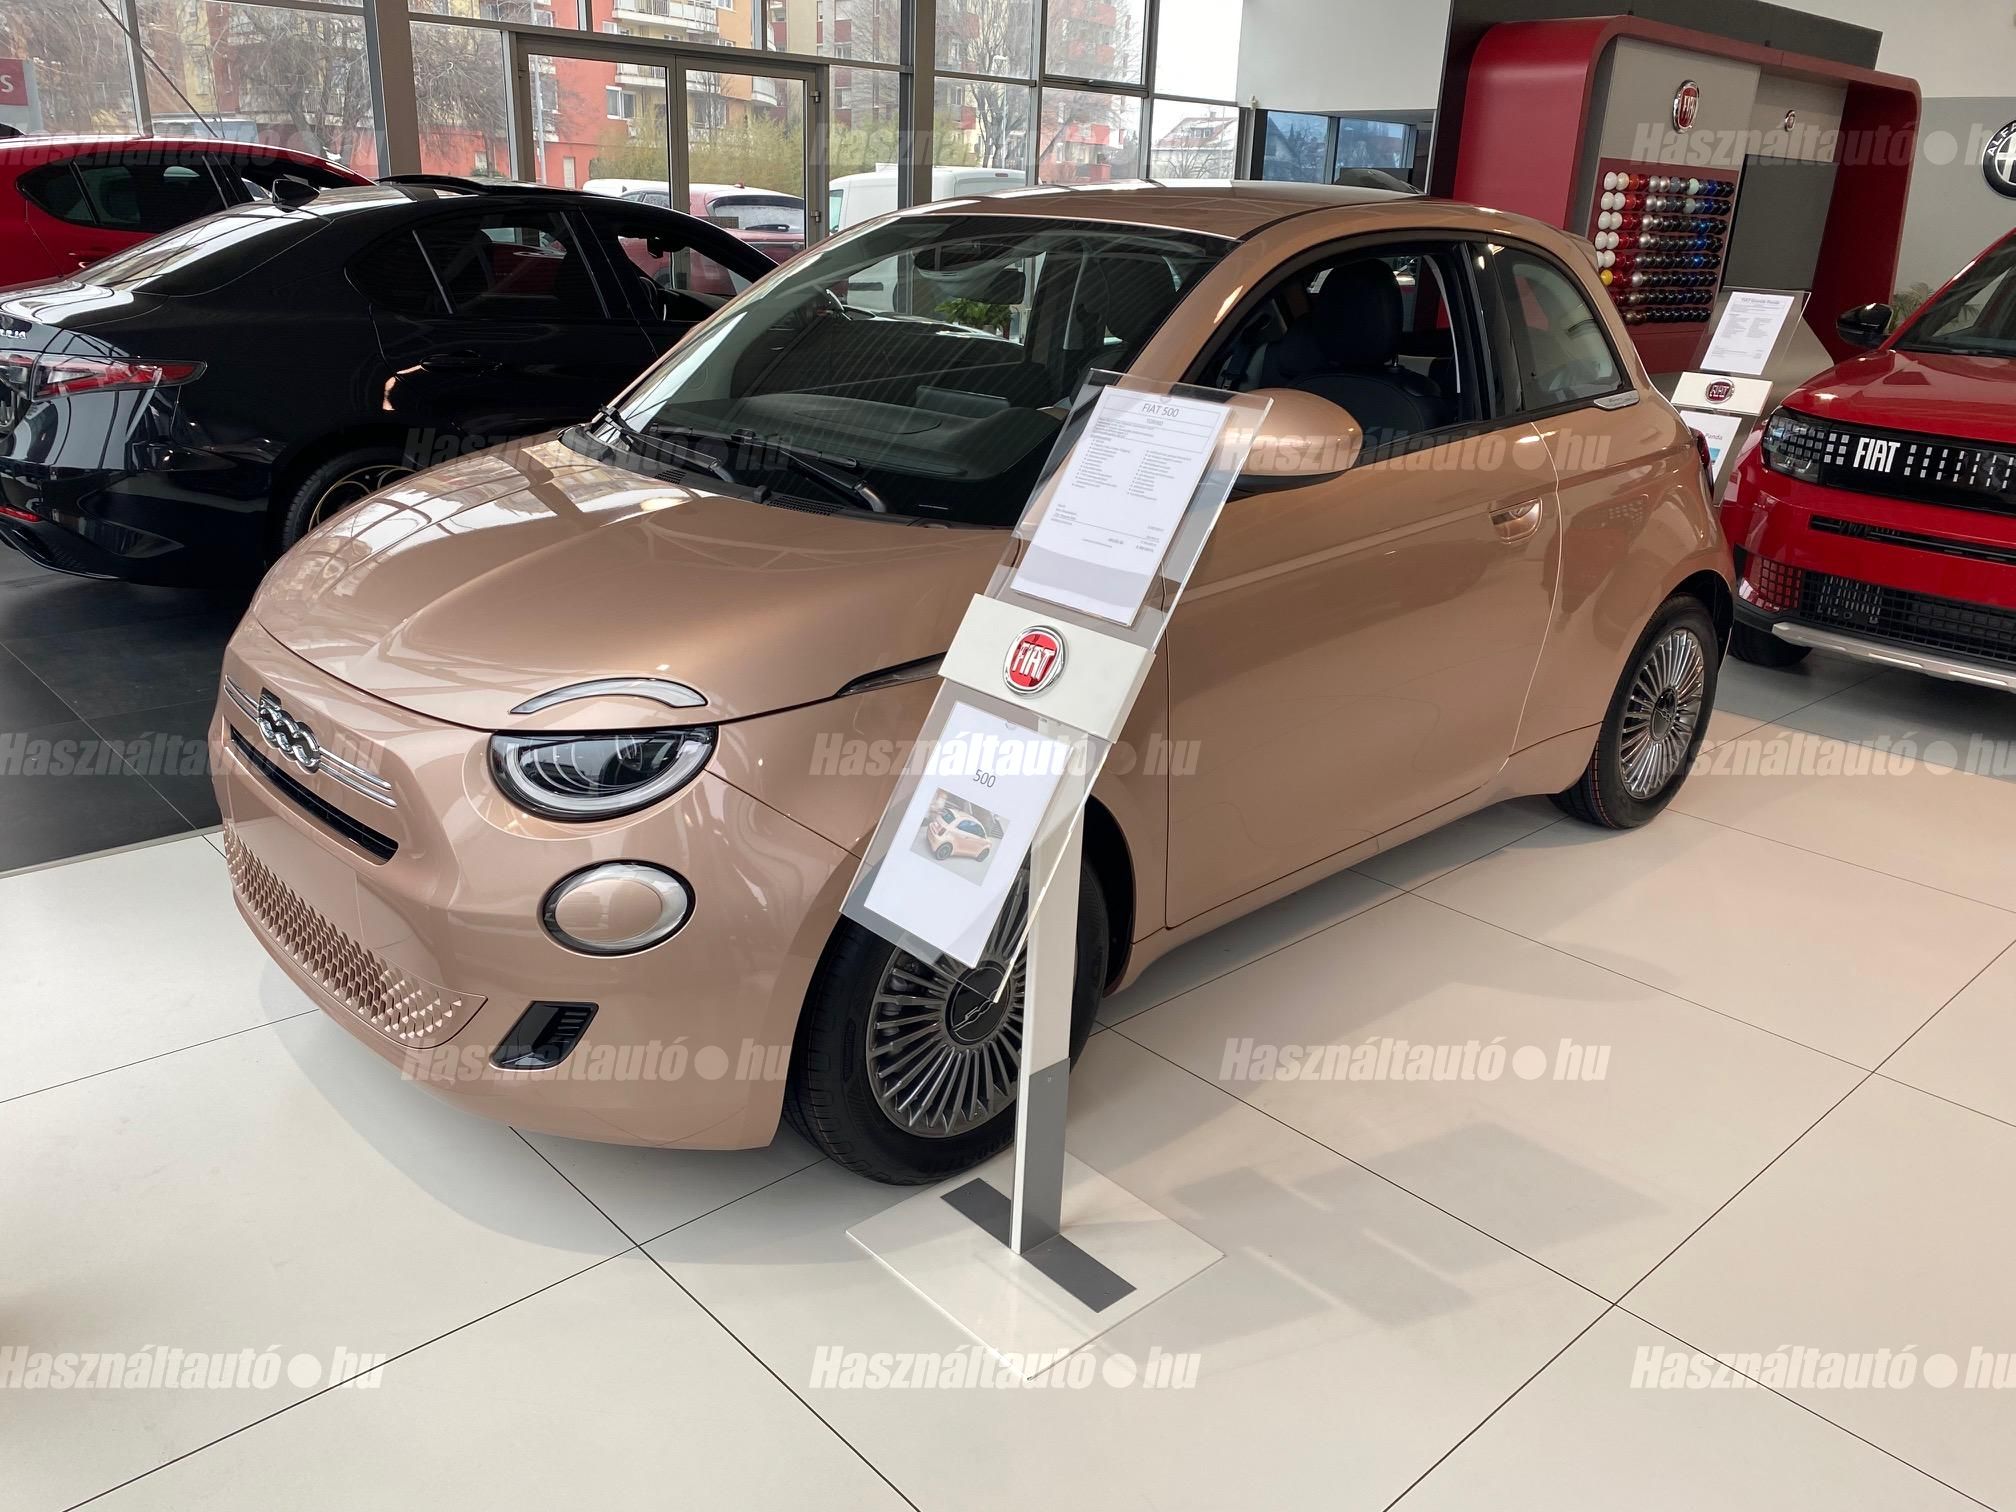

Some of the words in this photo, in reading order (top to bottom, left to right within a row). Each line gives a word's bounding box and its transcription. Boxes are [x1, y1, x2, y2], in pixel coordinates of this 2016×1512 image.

[1710, 385, 1730, 397] FIAT
[1142, 403, 1162, 414] FIAT
[1161, 407, 1179, 418] 500
[1853, 437, 1900, 473] FIAT
[1011, 642, 1056, 681] FIAT
[972, 768, 996, 788] 500
